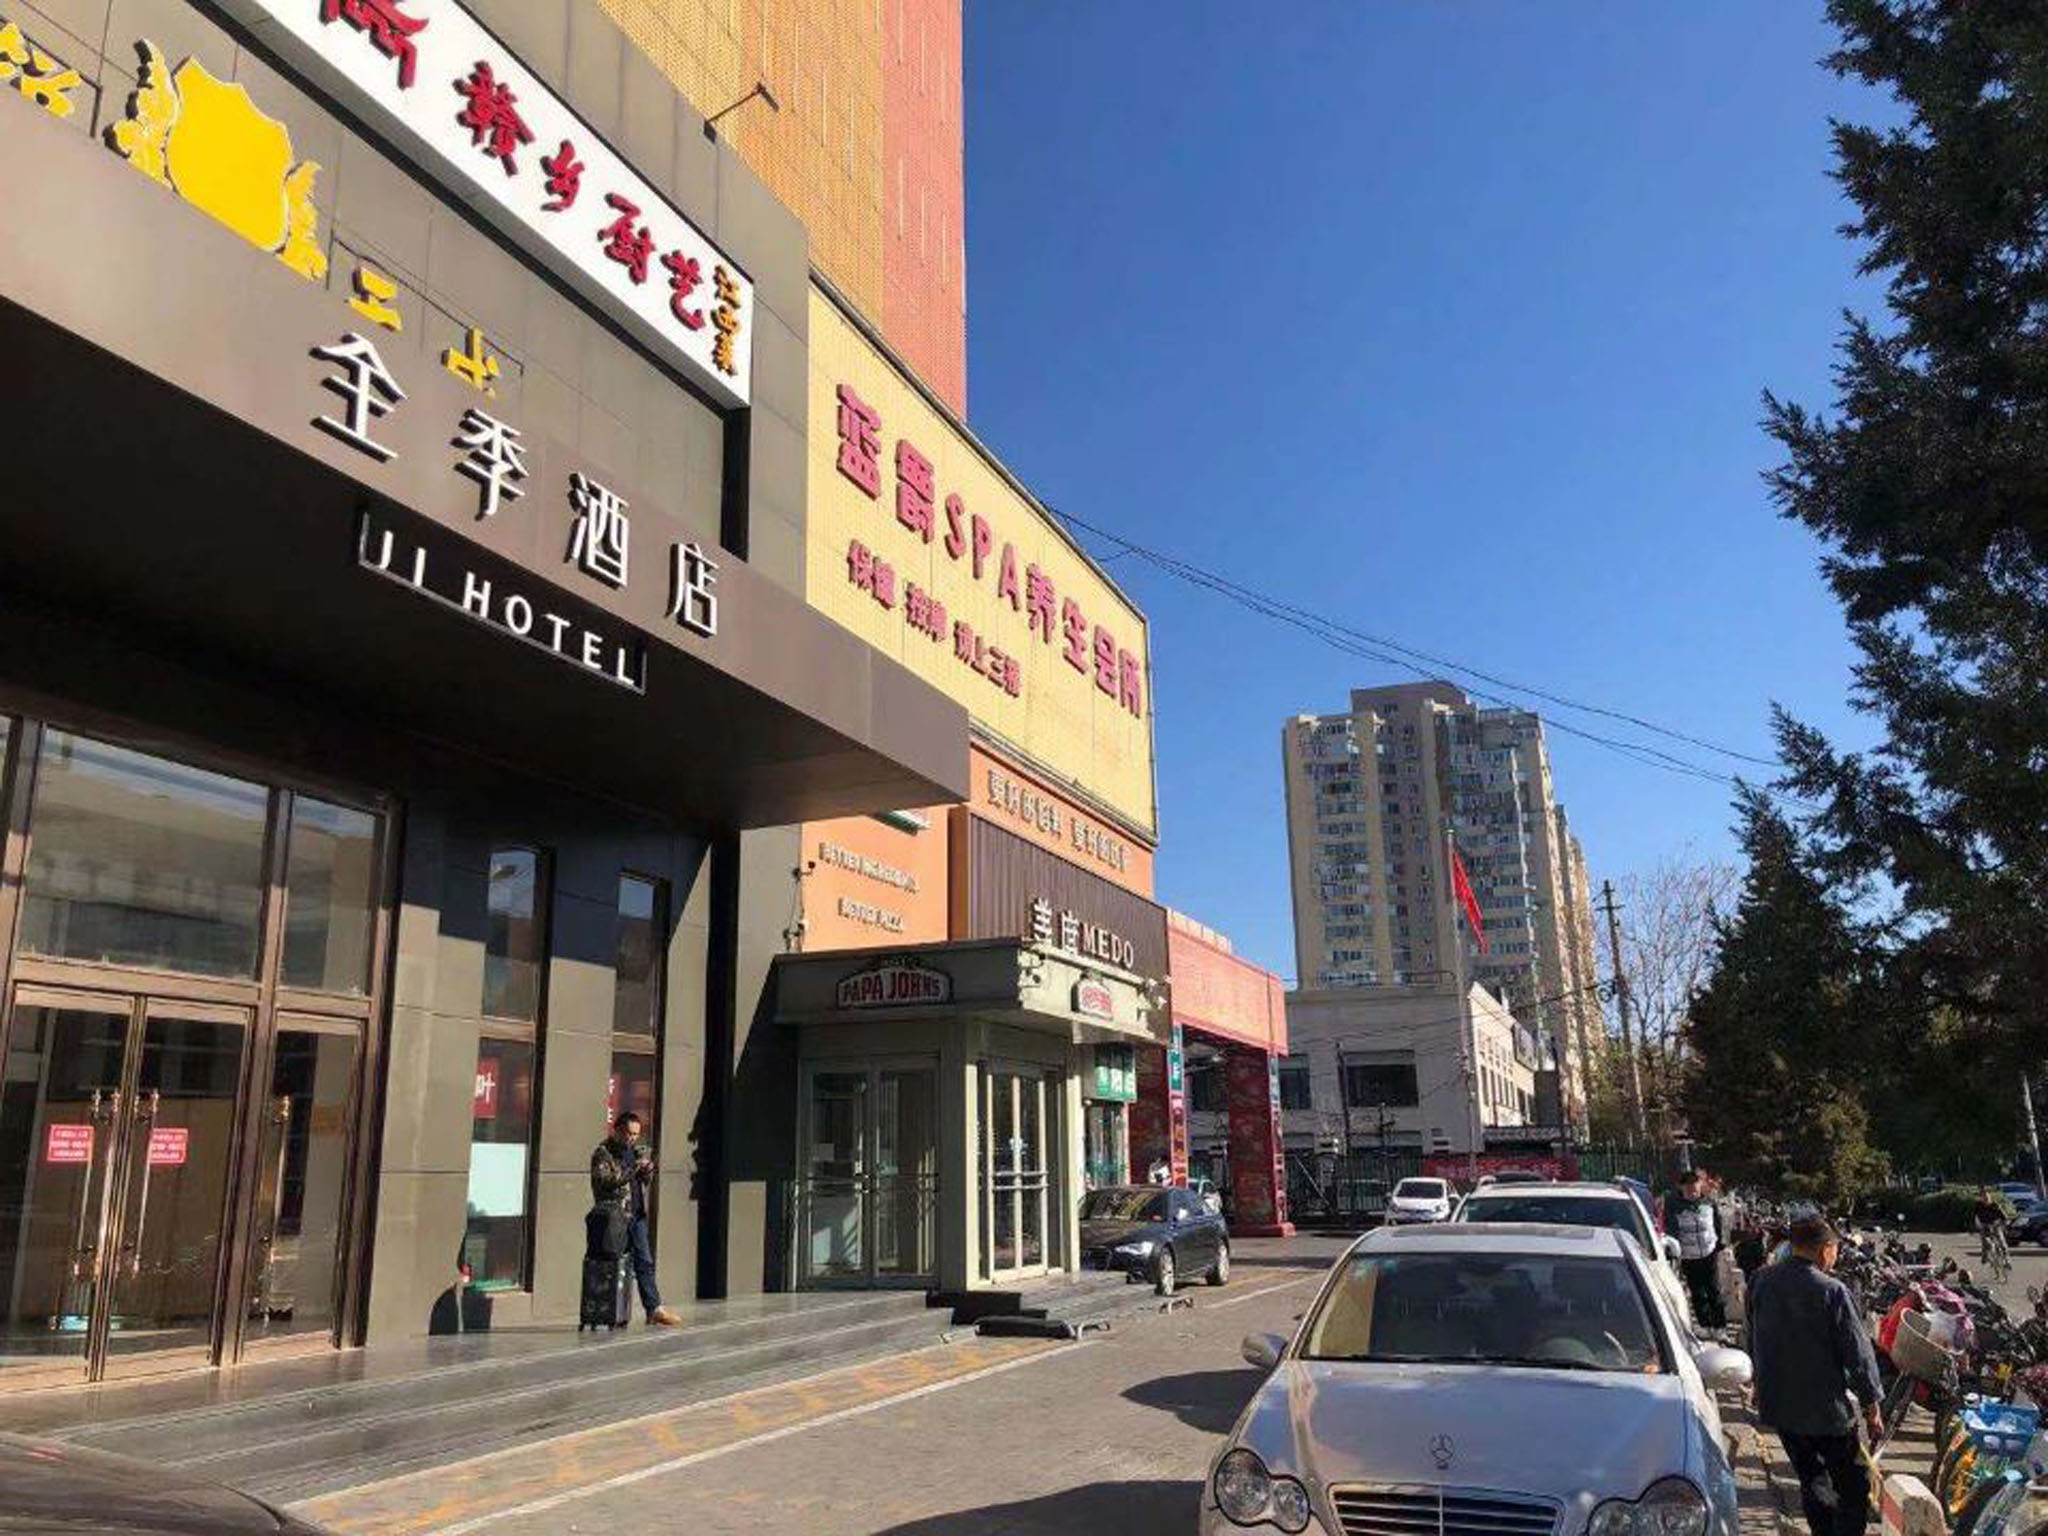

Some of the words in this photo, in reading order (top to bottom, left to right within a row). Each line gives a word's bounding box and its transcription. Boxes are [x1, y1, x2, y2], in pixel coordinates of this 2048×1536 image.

[312, 332, 719, 636] 全季酒店
[463, 571, 635, 686] HOTEL
